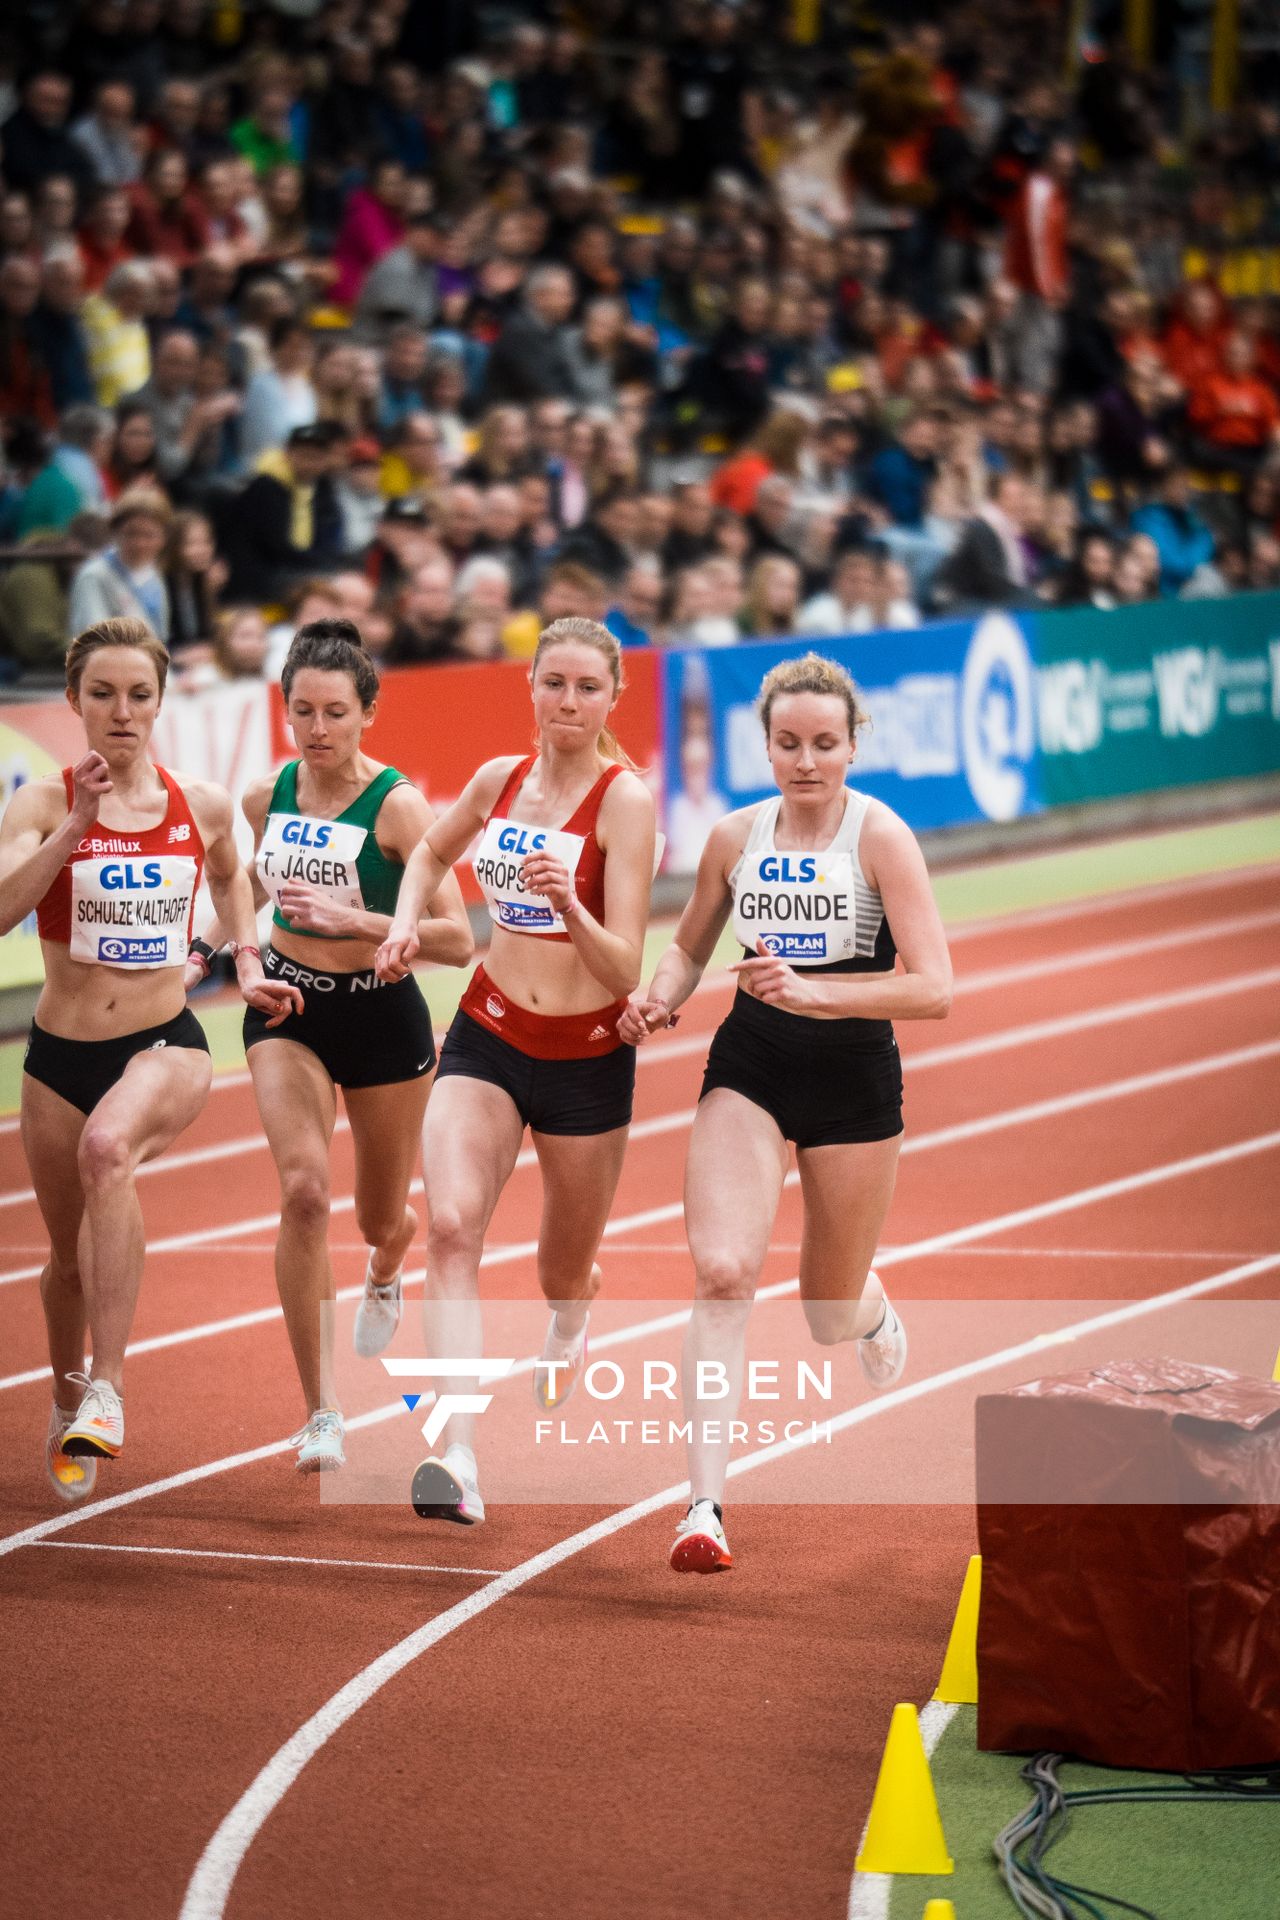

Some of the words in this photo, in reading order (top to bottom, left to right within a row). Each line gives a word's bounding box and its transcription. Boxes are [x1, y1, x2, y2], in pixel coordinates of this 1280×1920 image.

[264, 851, 275, 877] T.
[280, 848, 349, 887] JÄGER
[77, 899, 133, 926] SCHULZE
[136, 896, 189, 926] KALTHOFF
[514, 907, 549, 918] PLAN
[740, 892, 848, 920] GRONDE
[129, 941, 166, 955] PLAN
[785, 937, 824, 949] PLAN
[278, 961, 336, 992] PRO
